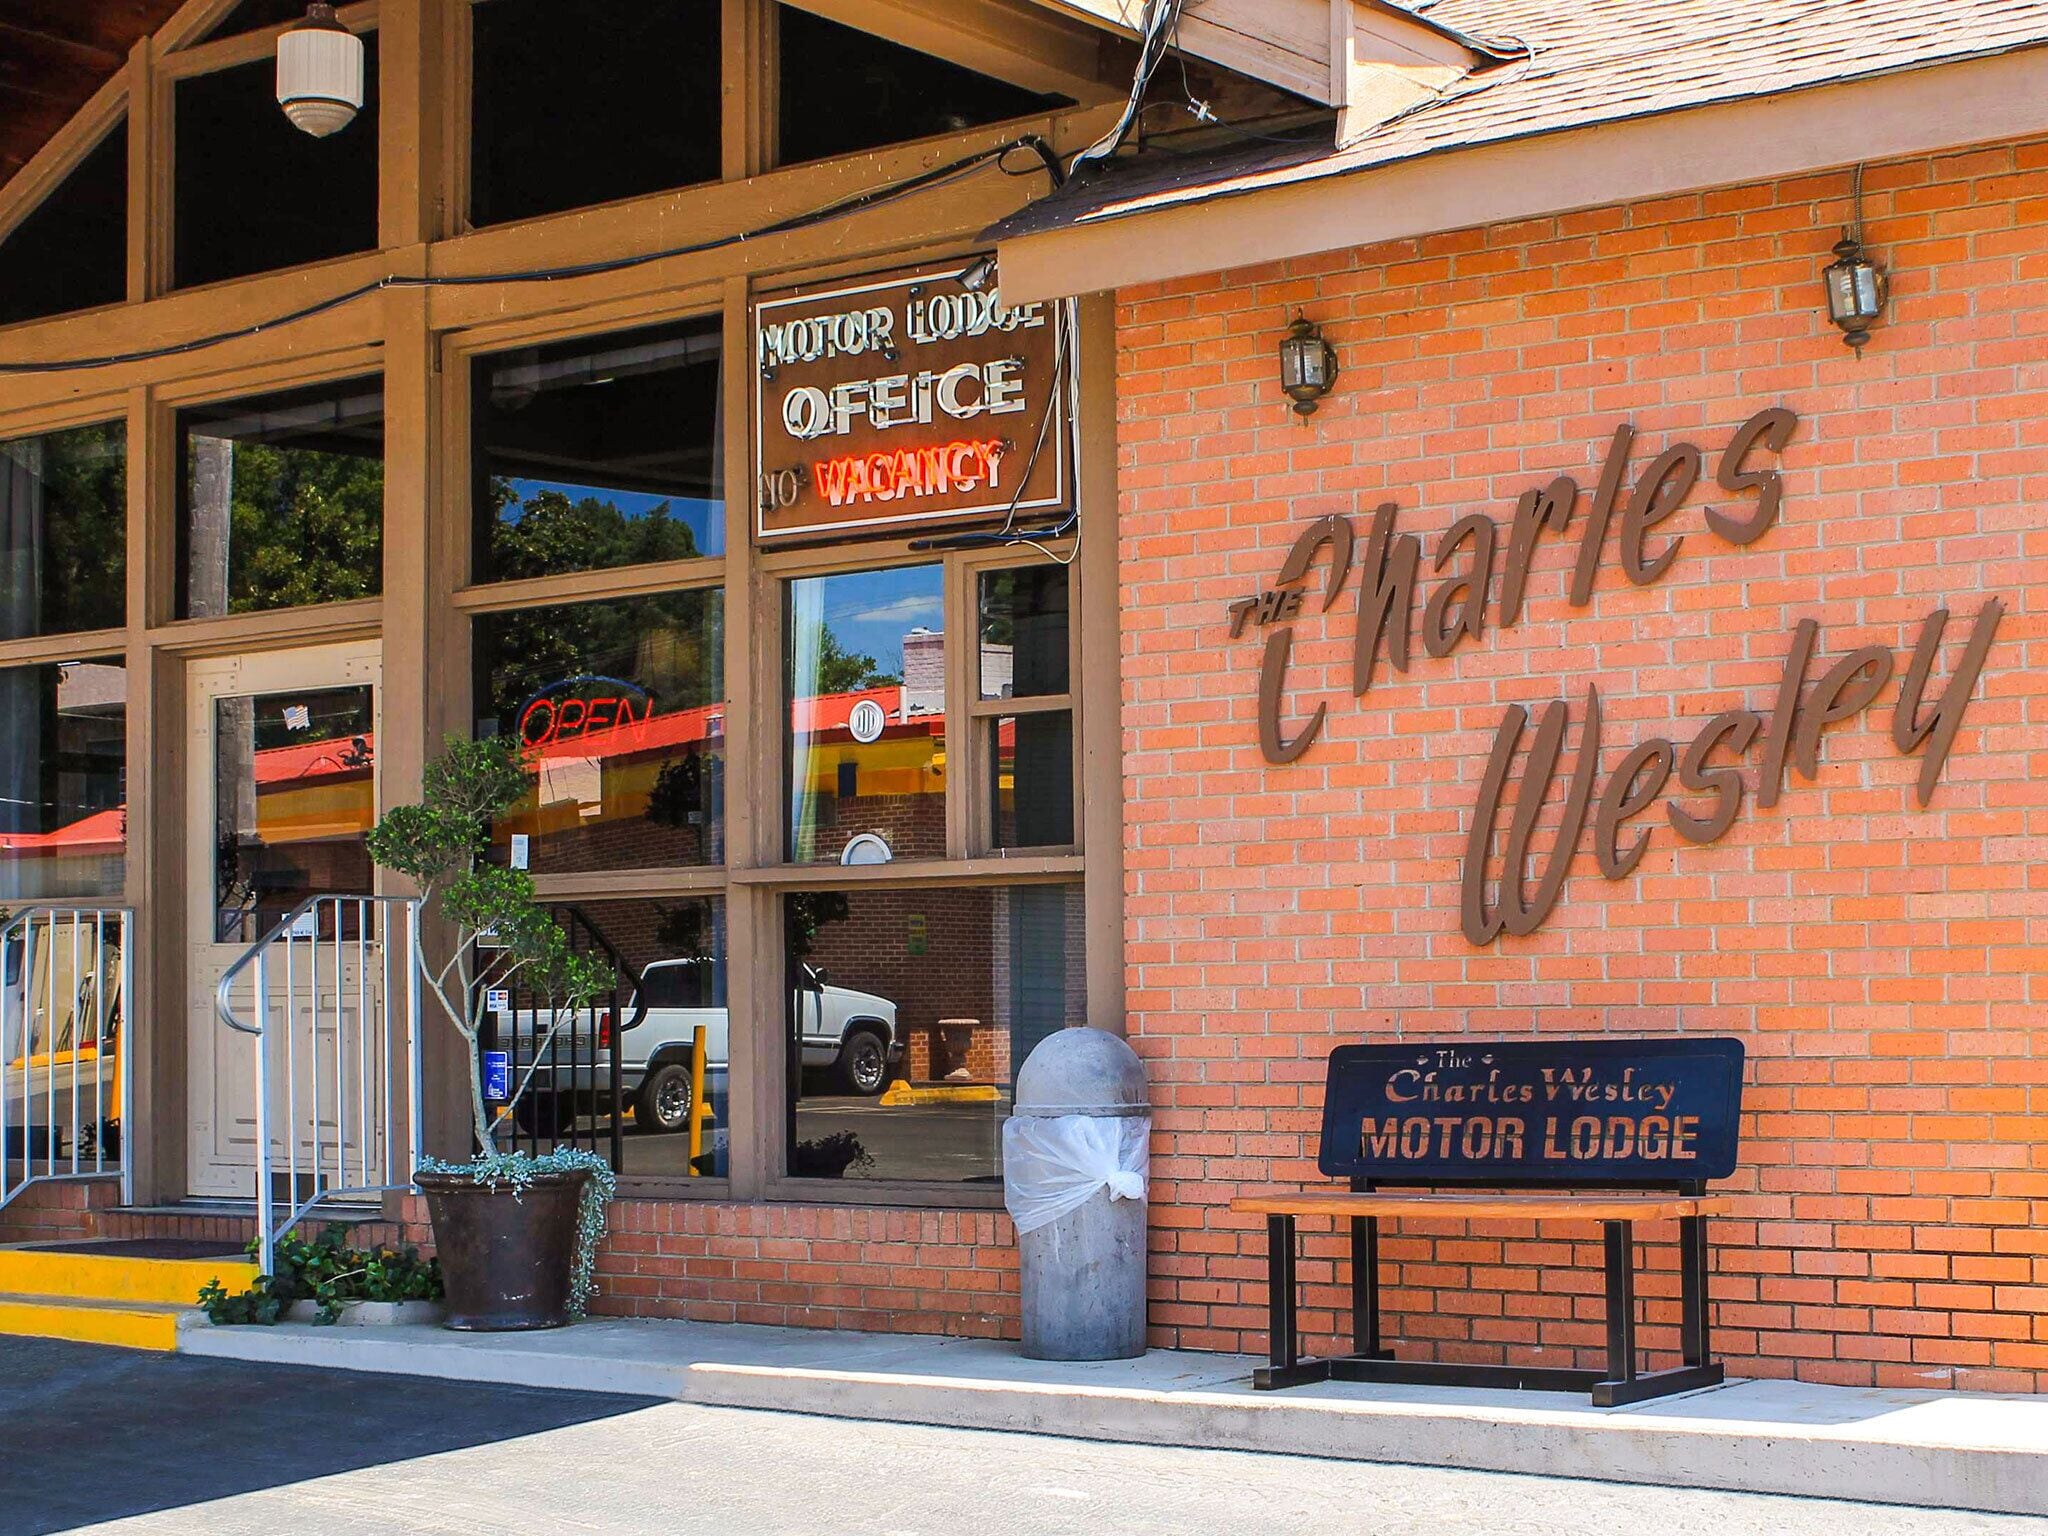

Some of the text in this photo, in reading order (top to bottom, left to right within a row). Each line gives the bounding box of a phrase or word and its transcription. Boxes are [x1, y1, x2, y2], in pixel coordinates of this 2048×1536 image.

[759, 306, 895, 366] MOTOR
[782, 359, 1026, 439] OFFICE
[760, 440, 1005, 508] NO VACANCY
[1229, 408, 1798, 765] THE Charles
[520, 697, 655, 746] OPEN
[1462, 595, 1999, 947] Wesley
[1385, 1067, 1676, 1111] Charles Wesley
[1436, 1050, 1472, 1069] The
[1361, 1116, 1700, 1160] MOTOR LODGE
